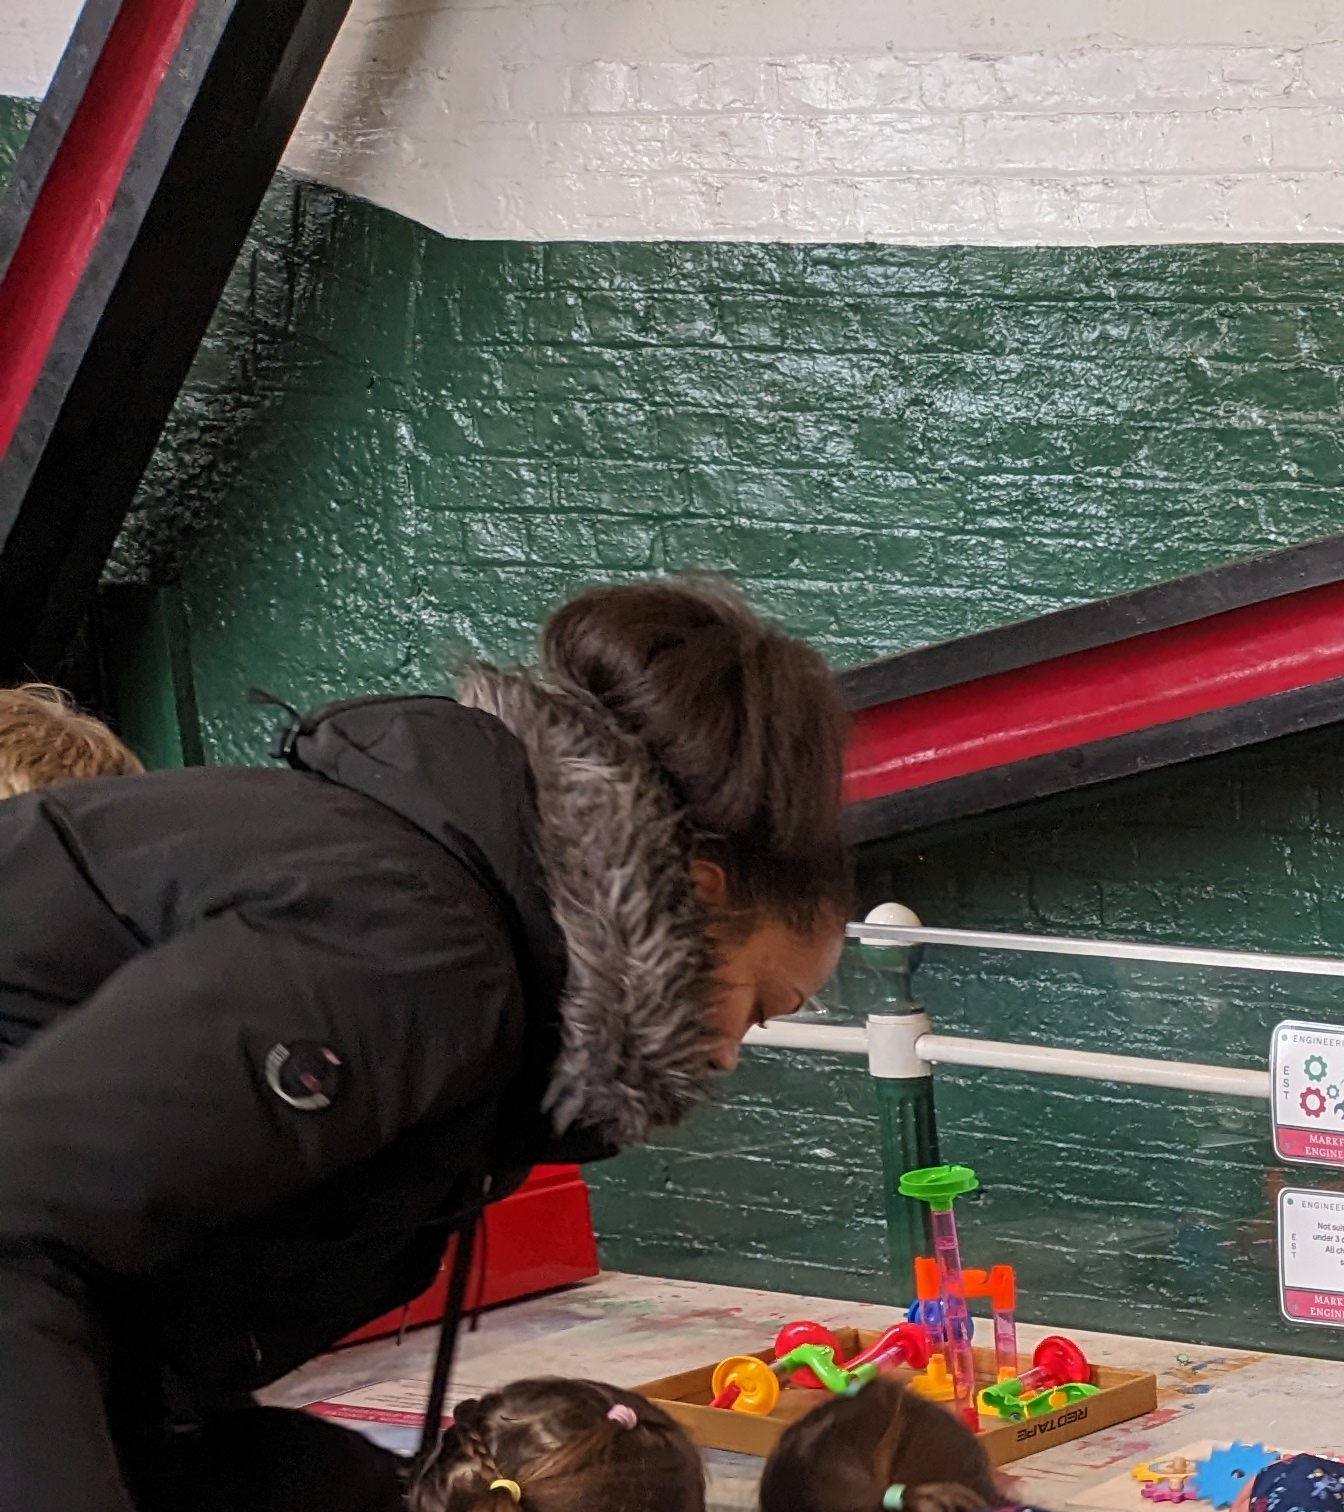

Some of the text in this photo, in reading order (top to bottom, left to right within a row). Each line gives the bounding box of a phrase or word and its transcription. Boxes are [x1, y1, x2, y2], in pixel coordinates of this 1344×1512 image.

[1305, 1147, 1343, 1159] ENGINE
[1318, 1222, 1331, 1230] Not
[1313, 1234, 1333, 1242] under
